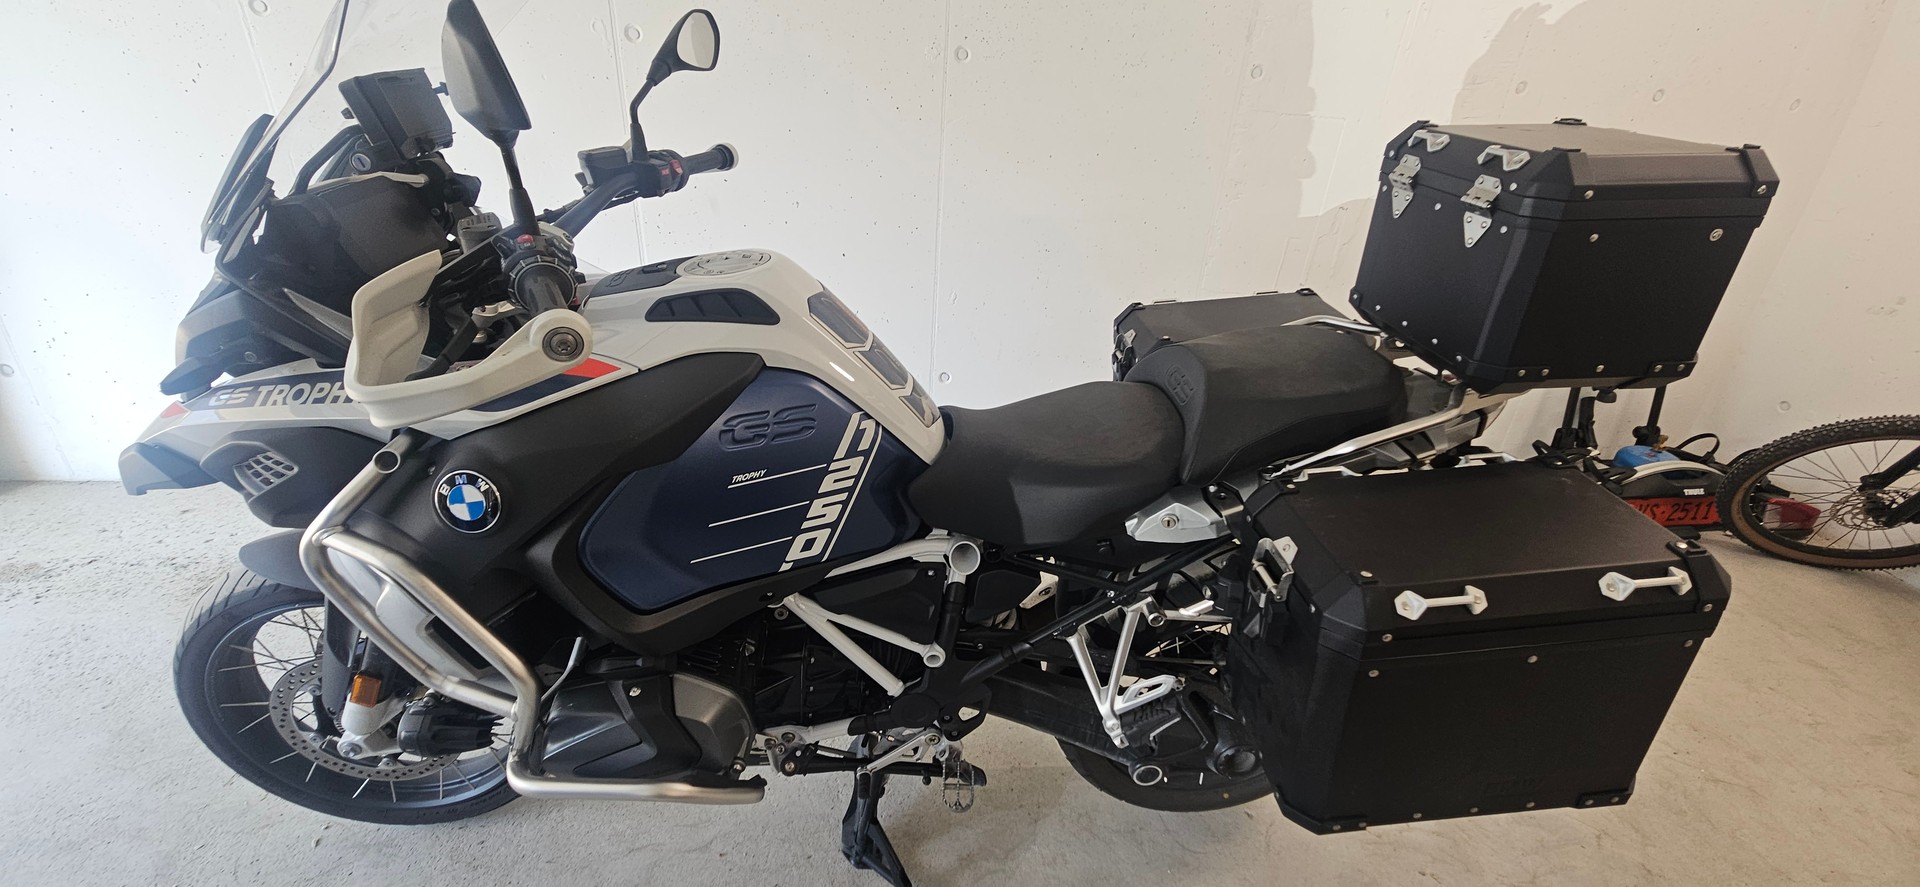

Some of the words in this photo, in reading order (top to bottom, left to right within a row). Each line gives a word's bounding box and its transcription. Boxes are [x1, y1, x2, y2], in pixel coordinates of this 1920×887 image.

[208, 386, 255, 407] GS
[253, 382, 357, 407] TROPH
[719, 404, 818, 451] GS
[439, 474, 490, 496] BMW
[731, 469, 767, 483] TROPHY
[785, 418, 876, 562] 1250
